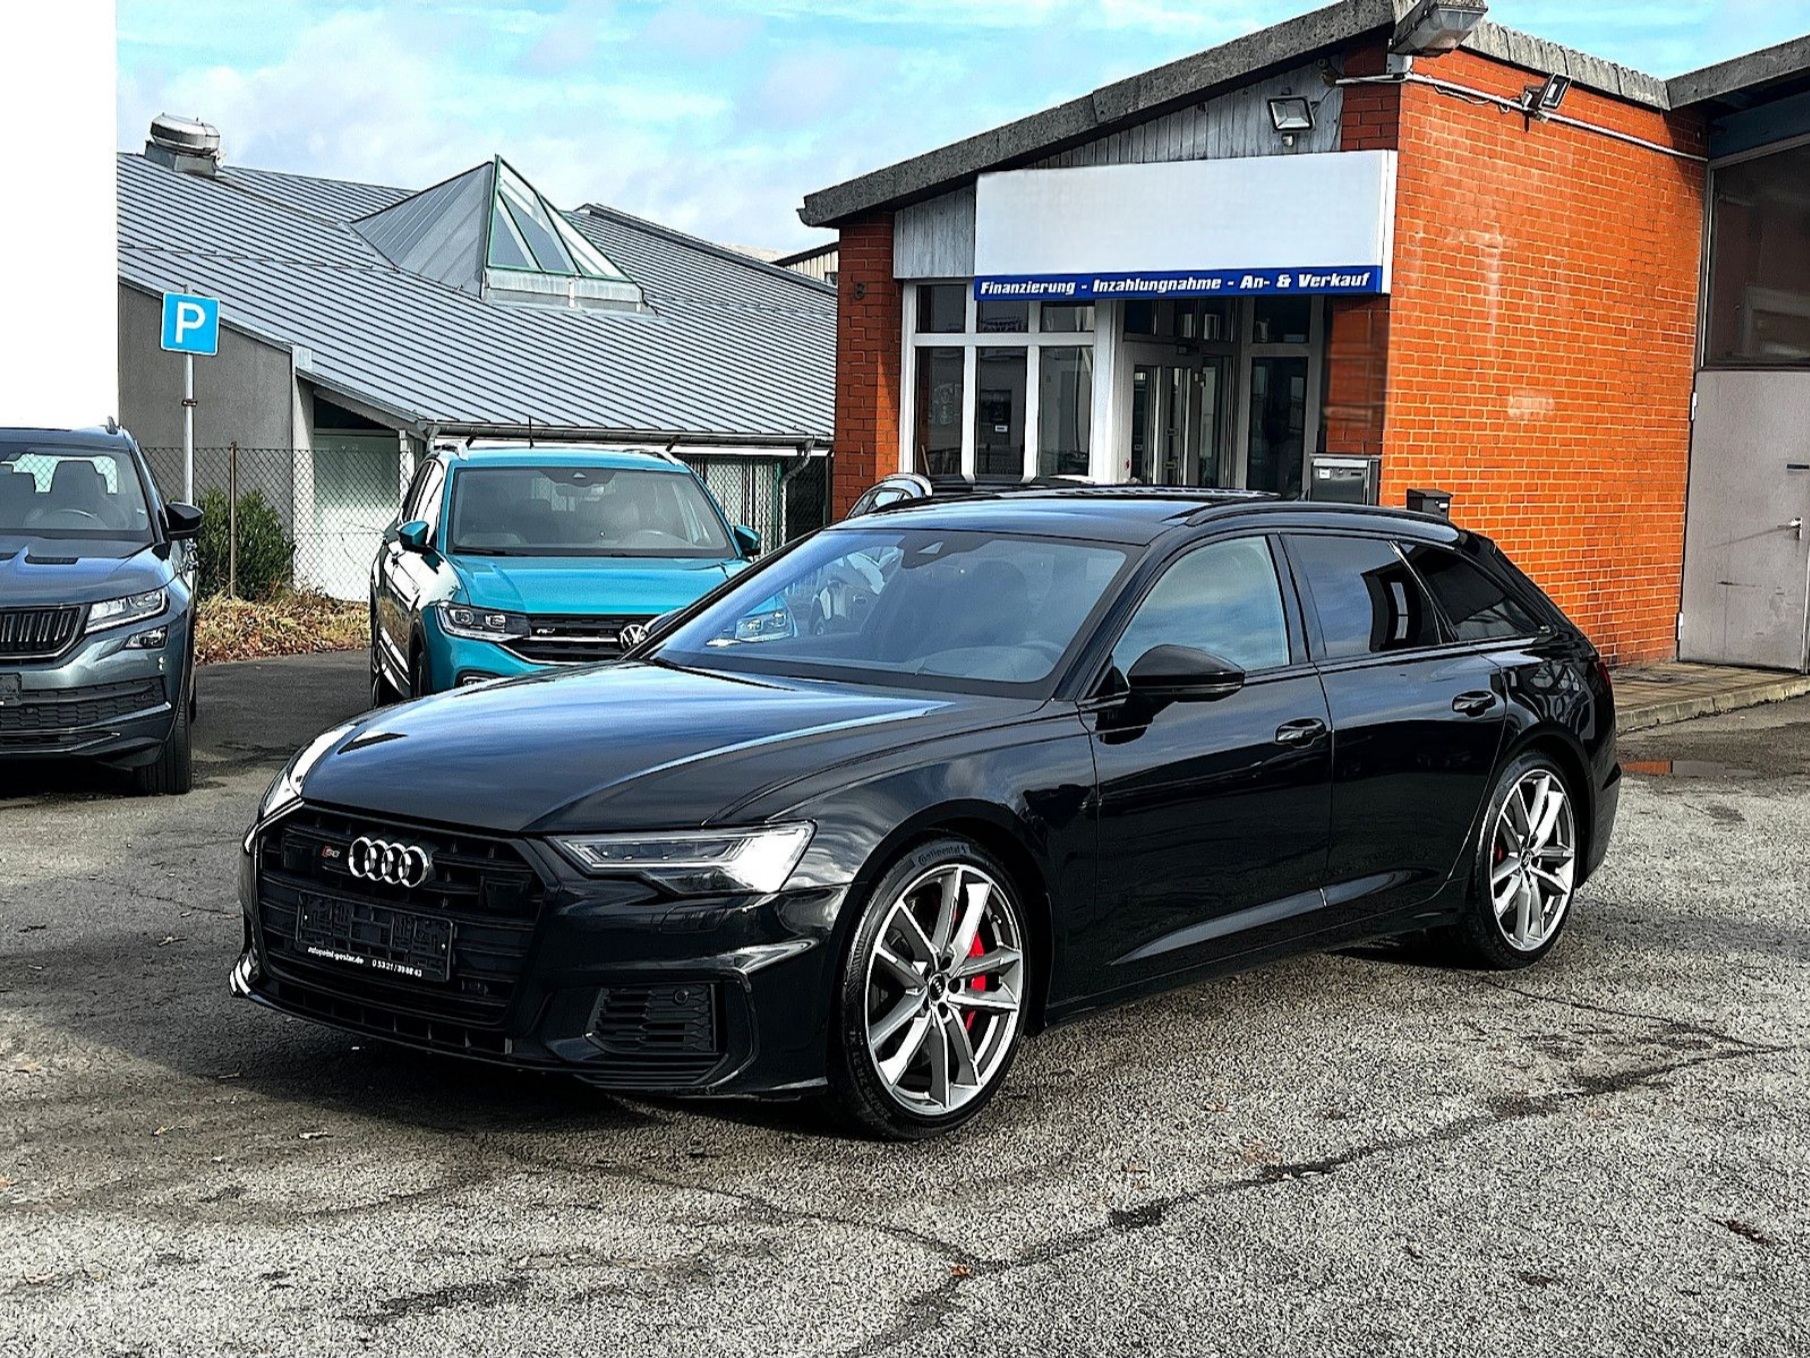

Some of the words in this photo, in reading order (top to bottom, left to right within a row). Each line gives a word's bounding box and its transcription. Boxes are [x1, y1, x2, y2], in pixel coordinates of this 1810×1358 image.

[980, 281, 1076, 296] Finanzierung
[1093, 277, 1221, 293] Inzahlungnahme
[1240, 275, 1271, 289] An-
[1276, 274, 1292, 288] &
[1298, 272, 1371, 288] Verkauf
[175, 301, 206, 344] P
[918, 845, 960, 867] Continental
